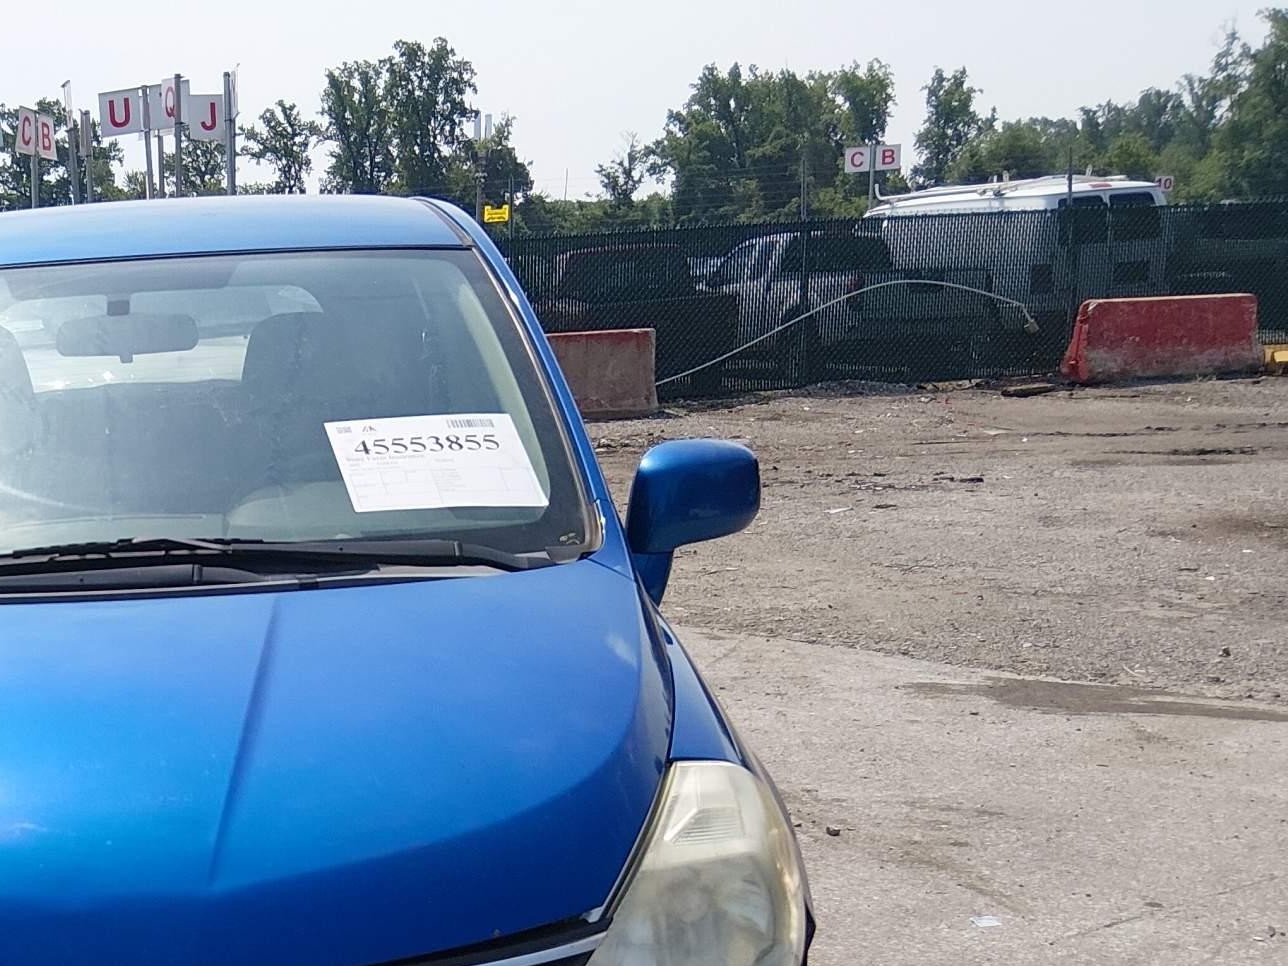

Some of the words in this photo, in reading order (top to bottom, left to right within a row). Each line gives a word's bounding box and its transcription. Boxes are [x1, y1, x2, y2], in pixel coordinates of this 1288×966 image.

[107, 97, 131, 129] U
[165, 85, 177, 119] Q
[201, 101, 218, 131] J
[21, 114, 32, 146] C
[40, 120, 52, 152] B
[850, 151, 865, 167] C
[881, 149, 896, 165] B
[353, 434, 501, 455] 45553855
